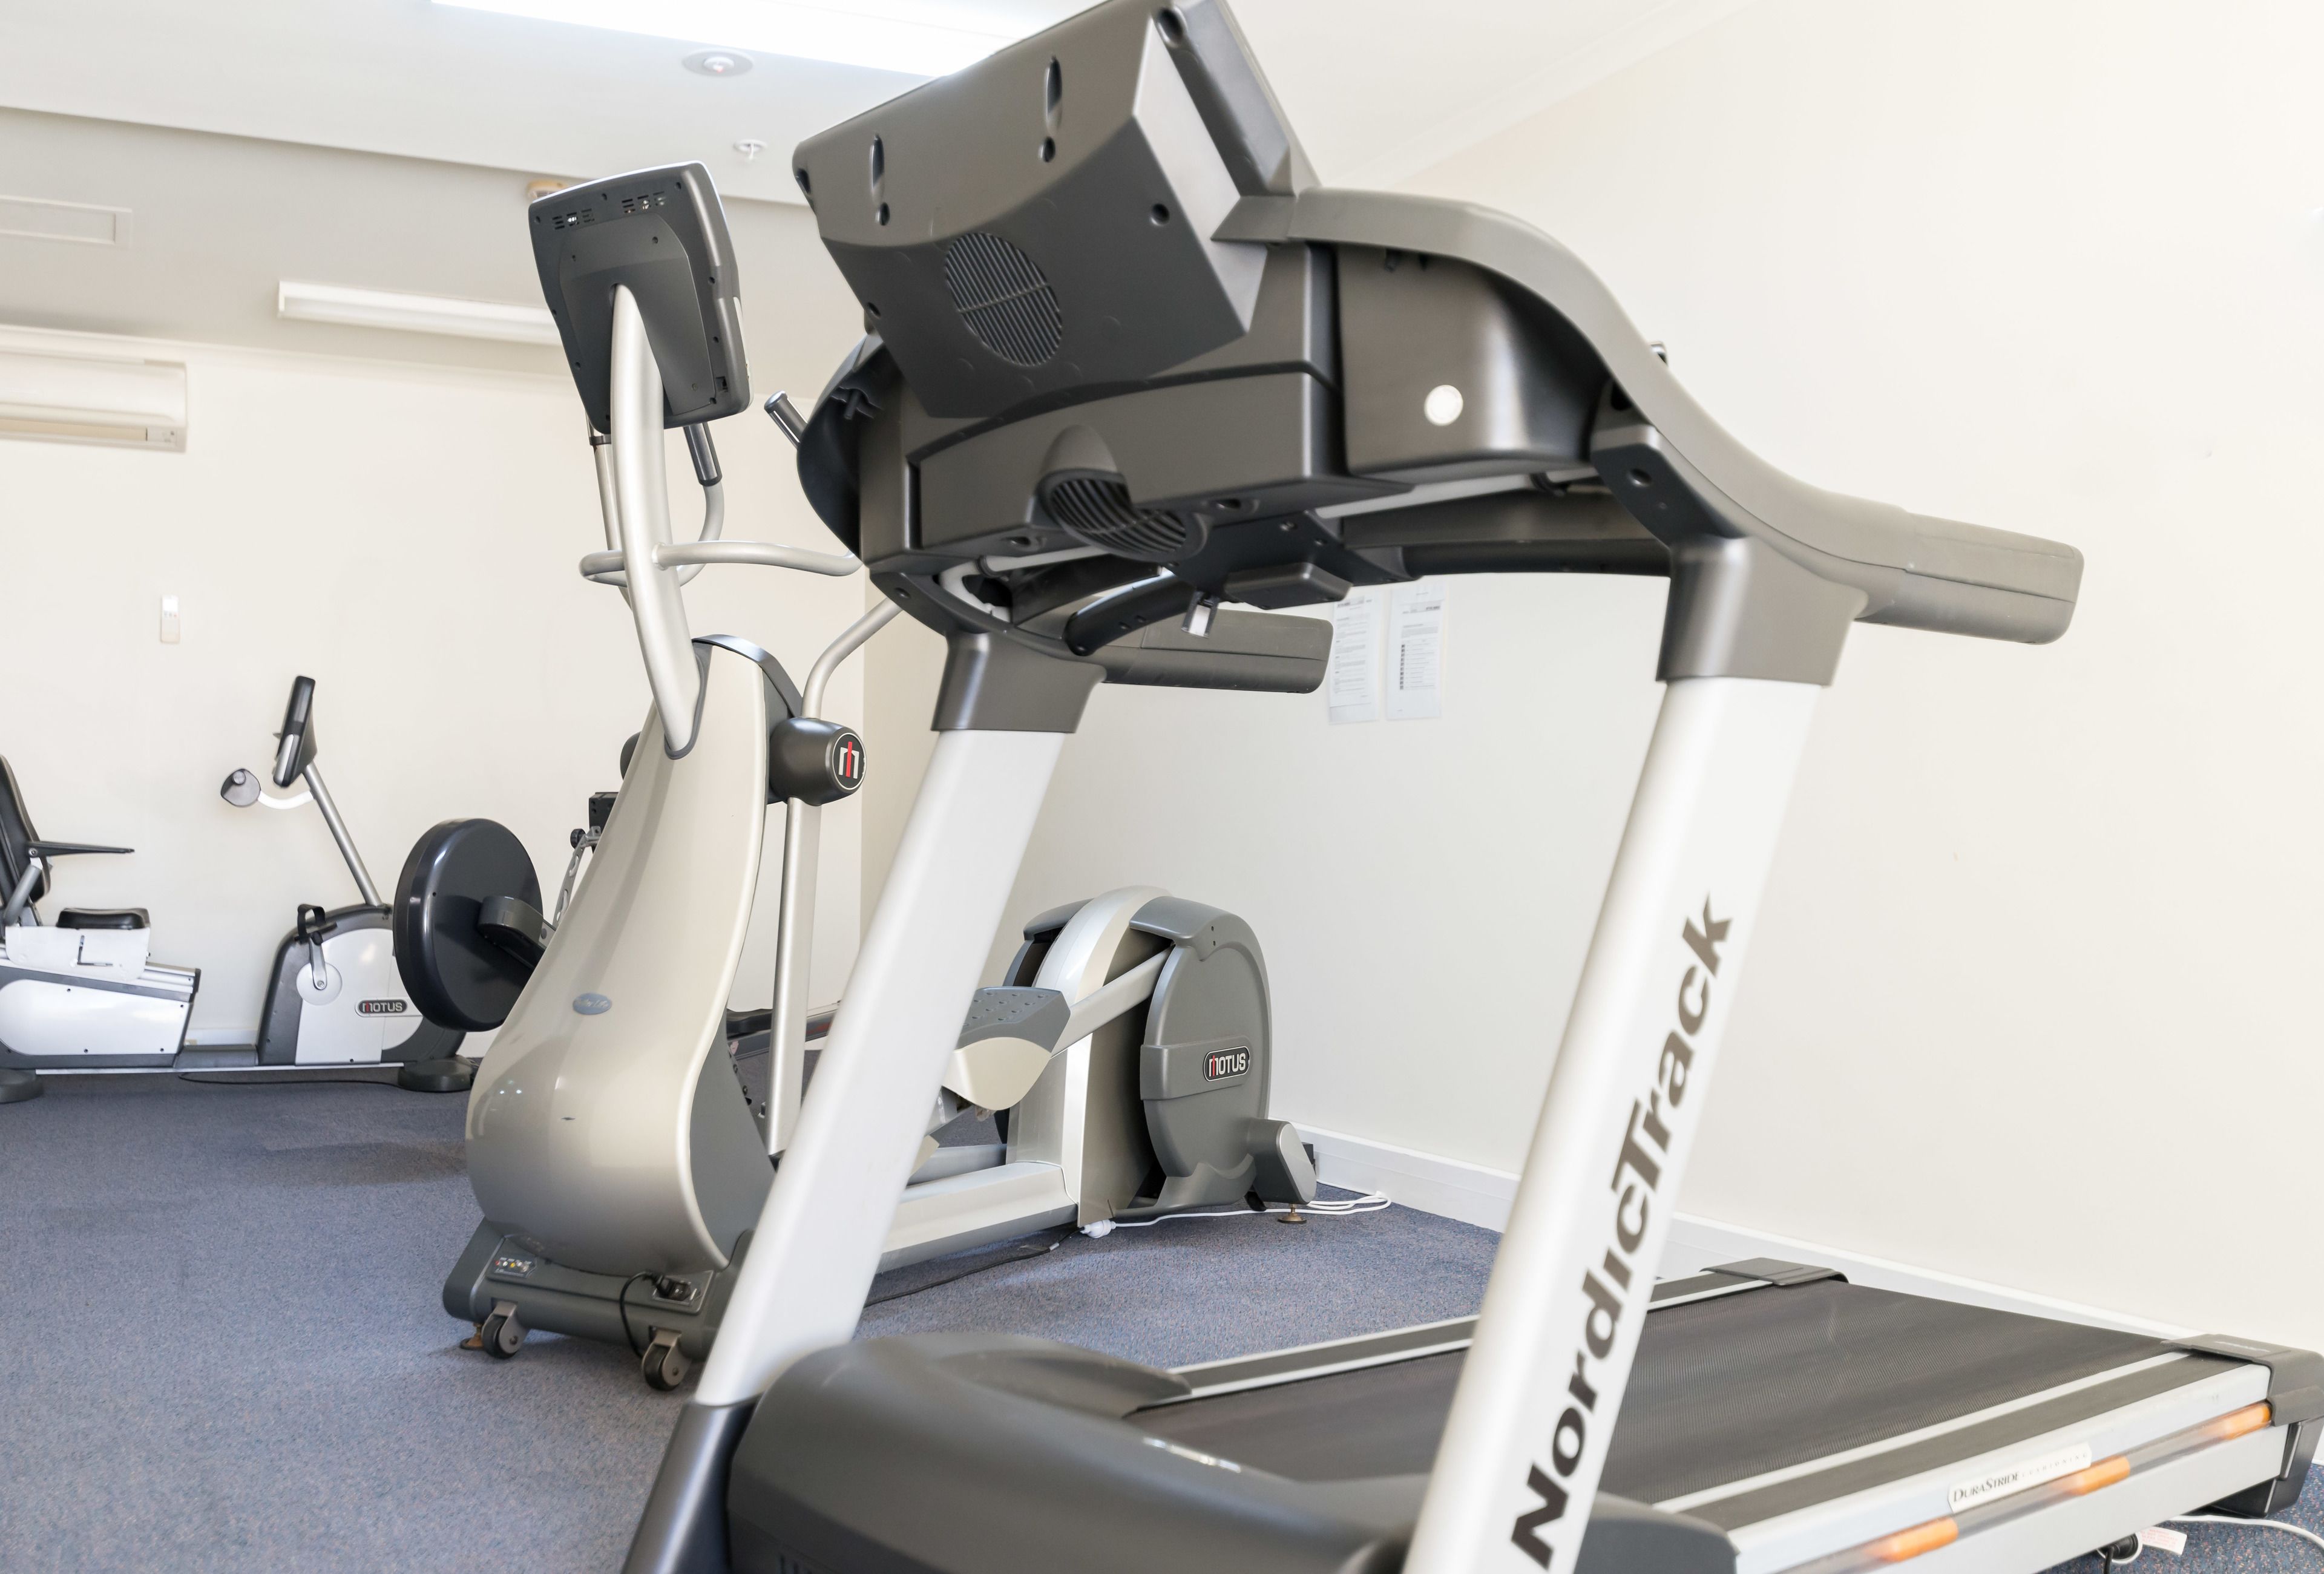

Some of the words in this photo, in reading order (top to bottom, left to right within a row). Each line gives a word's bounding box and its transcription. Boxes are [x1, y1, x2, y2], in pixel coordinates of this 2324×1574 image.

[363, 1001, 403, 1013] MOTUS
[1209, 1052, 1246, 1077] MOTUS
[1511, 892, 1733, 1572] NordicTrack
